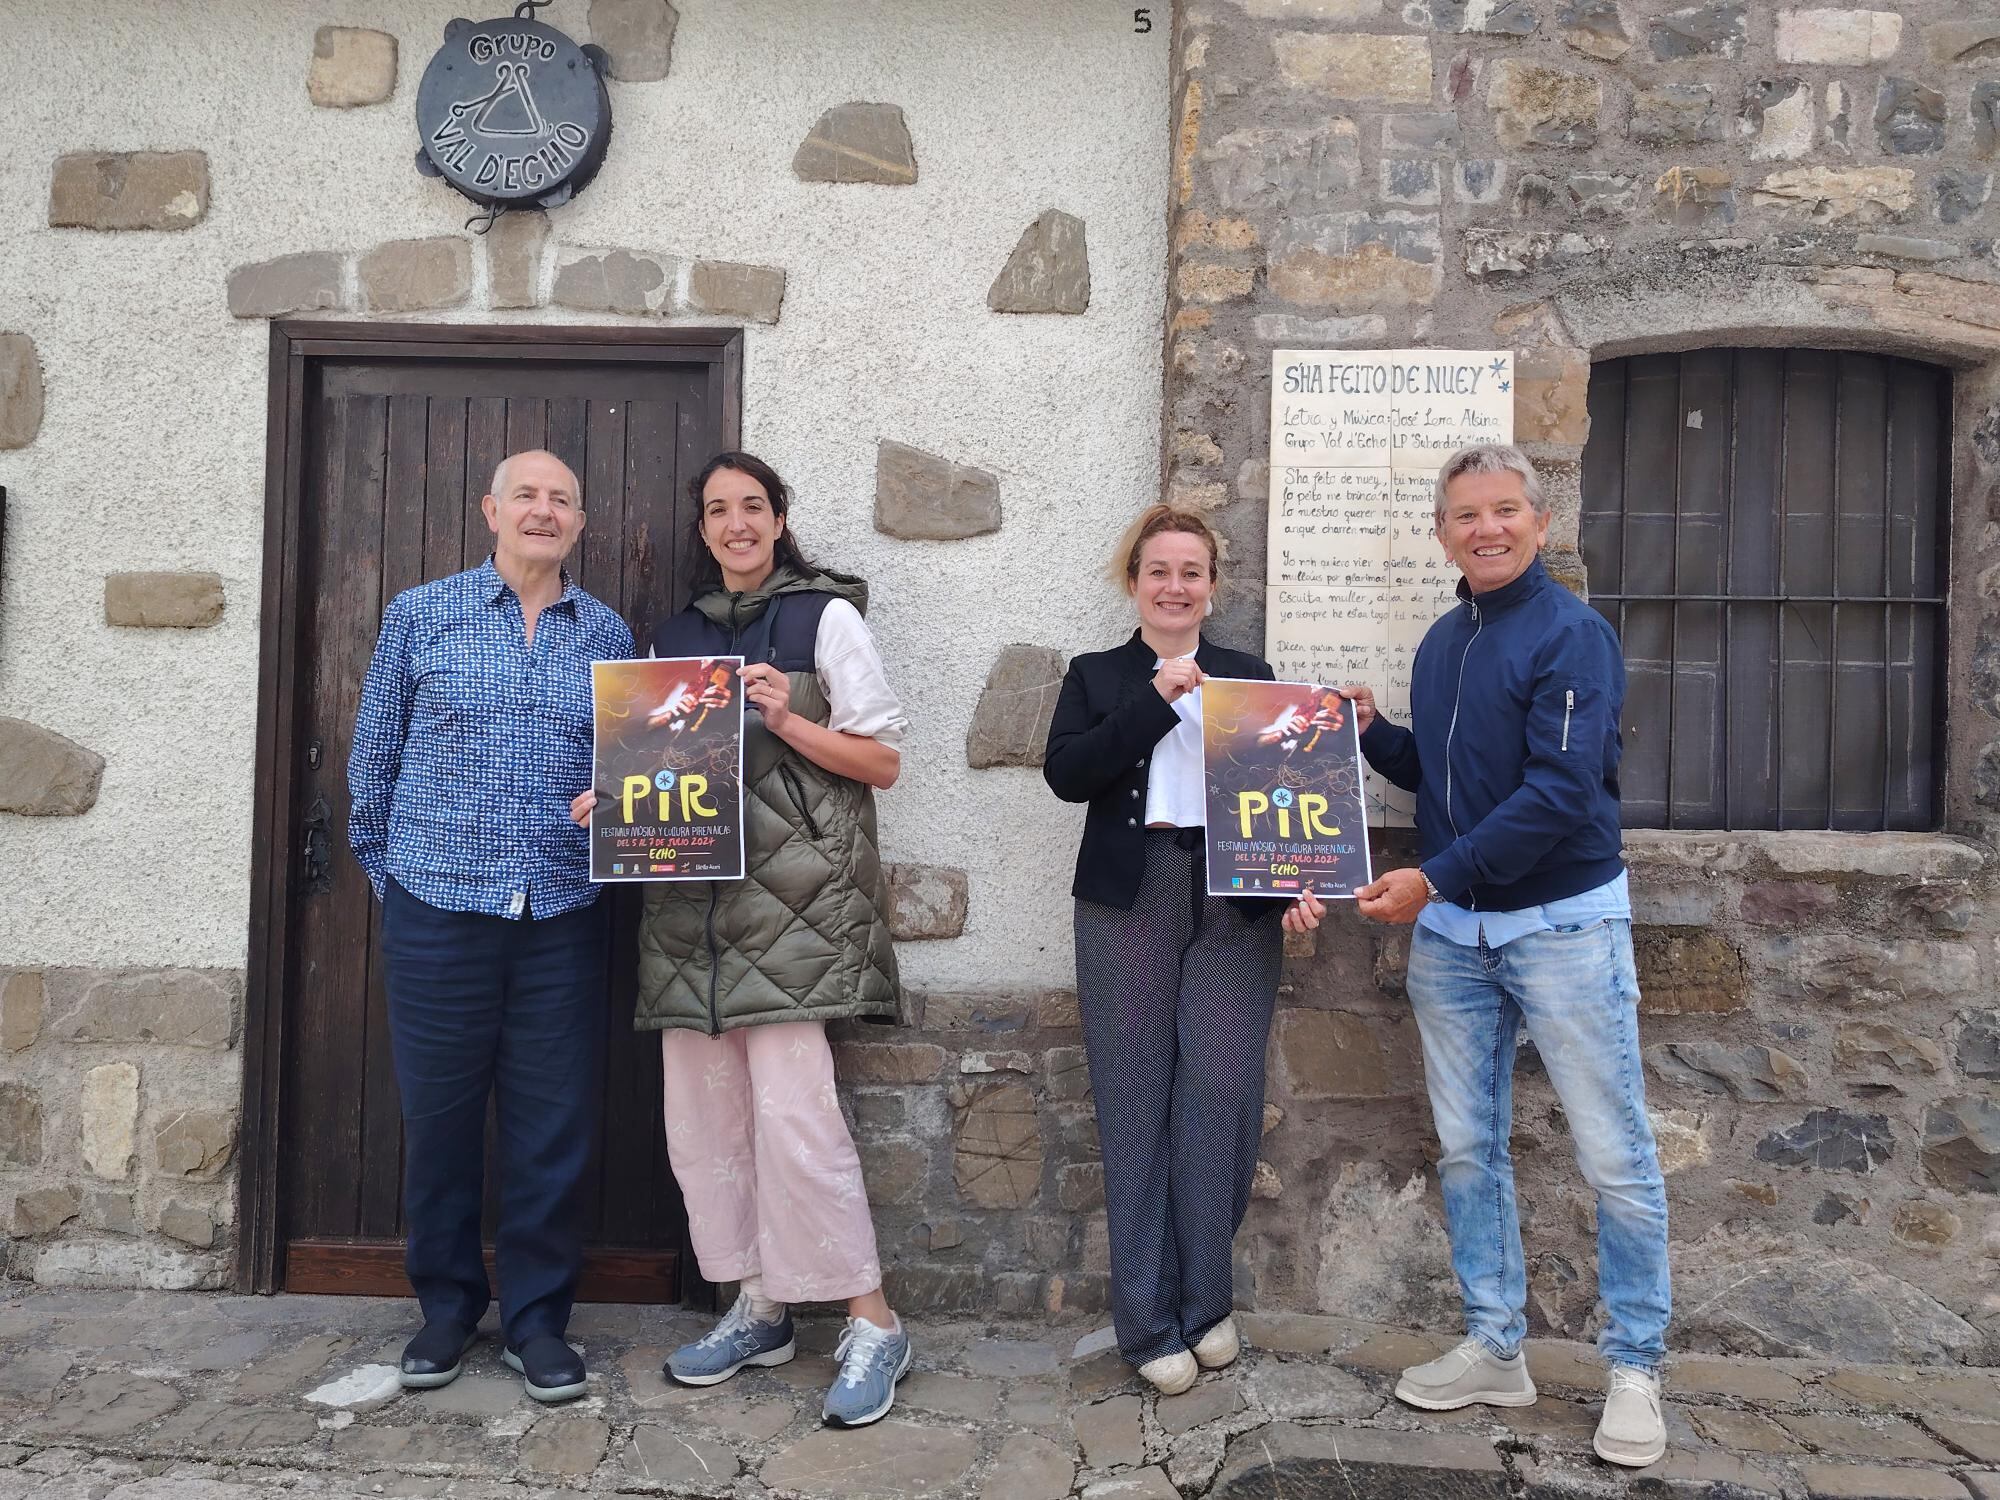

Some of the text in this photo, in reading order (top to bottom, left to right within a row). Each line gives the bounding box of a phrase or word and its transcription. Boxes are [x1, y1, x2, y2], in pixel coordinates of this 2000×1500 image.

[1134, 8, 1151, 33] 5
[468, 33, 556, 64] Grupo
[431, 116, 588, 190] VAL D'ECHO
[1391, 364, 1420, 393] DE
[1424, 365, 1483, 394] NUEY
[1283, 406, 1325, 426] Letra
[1329, 416, 1337, 430] y
[1391, 408, 1418, 427] José
[1461, 408, 1499, 427] Alsina
[1285, 433, 1315, 452] Grupo
[1346, 432, 1387, 449] d'Echo
[1393, 434, 1408, 448] LP
[1313, 471, 1336, 491] feito
[1341, 472, 1352, 484] de
[1297, 490, 1321, 505] peito
[1298, 505, 1338, 517] nuestro
[1344, 509, 1376, 524] querer
[1359, 524, 1387, 536] muito
[1392, 528, 1400, 540] y
[1411, 525, 1421, 536] te
[1283, 550, 1295, 566] Yo
[1425, 556, 1437, 568] de
[1395, 576, 1414, 587] que
[1421, 575, 1446, 588] culpa
[1279, 590, 1322, 604] Escuita
[1410, 592, 1423, 603] de
[1433, 590, 1459, 610] plora
[1280, 610, 1293, 624] yo
[1332, 608, 1342, 618] he
[1276, 640, 1306, 653] Dicen
[1340, 644, 1369, 658] querer
[1394, 643, 1405, 653] de
[1278, 660, 1286, 672] y
[1291, 661, 1306, 675] que
[1347, 657, 1369, 673] fácil
[658, 827, 663, 836] Y
[691, 825, 731, 836] PIRENAICAS
[616, 838, 631, 847] DEL
[631, 838, 638, 847] 5
[638, 838, 648, 847] AL
[655, 838, 665, 846] DE
[667, 837, 689, 847] JULIO
[690, 836, 716, 846] 2024
[1278, 842, 1284, 851] Y
[1313, 844, 1356, 854] PIRENAICAS
[648, 847, 677, 860] ECHO
[1234, 853, 1249, 862] DEL
[1251, 853, 1257, 862] 5
[1258, 853, 1267, 862] AL
[1276, 854, 1287, 862] DE
[1289, 854, 1312, 863] JULIO
[1314, 854, 1340, 864] 2024
[1270, 863, 1299, 876] ECHO
